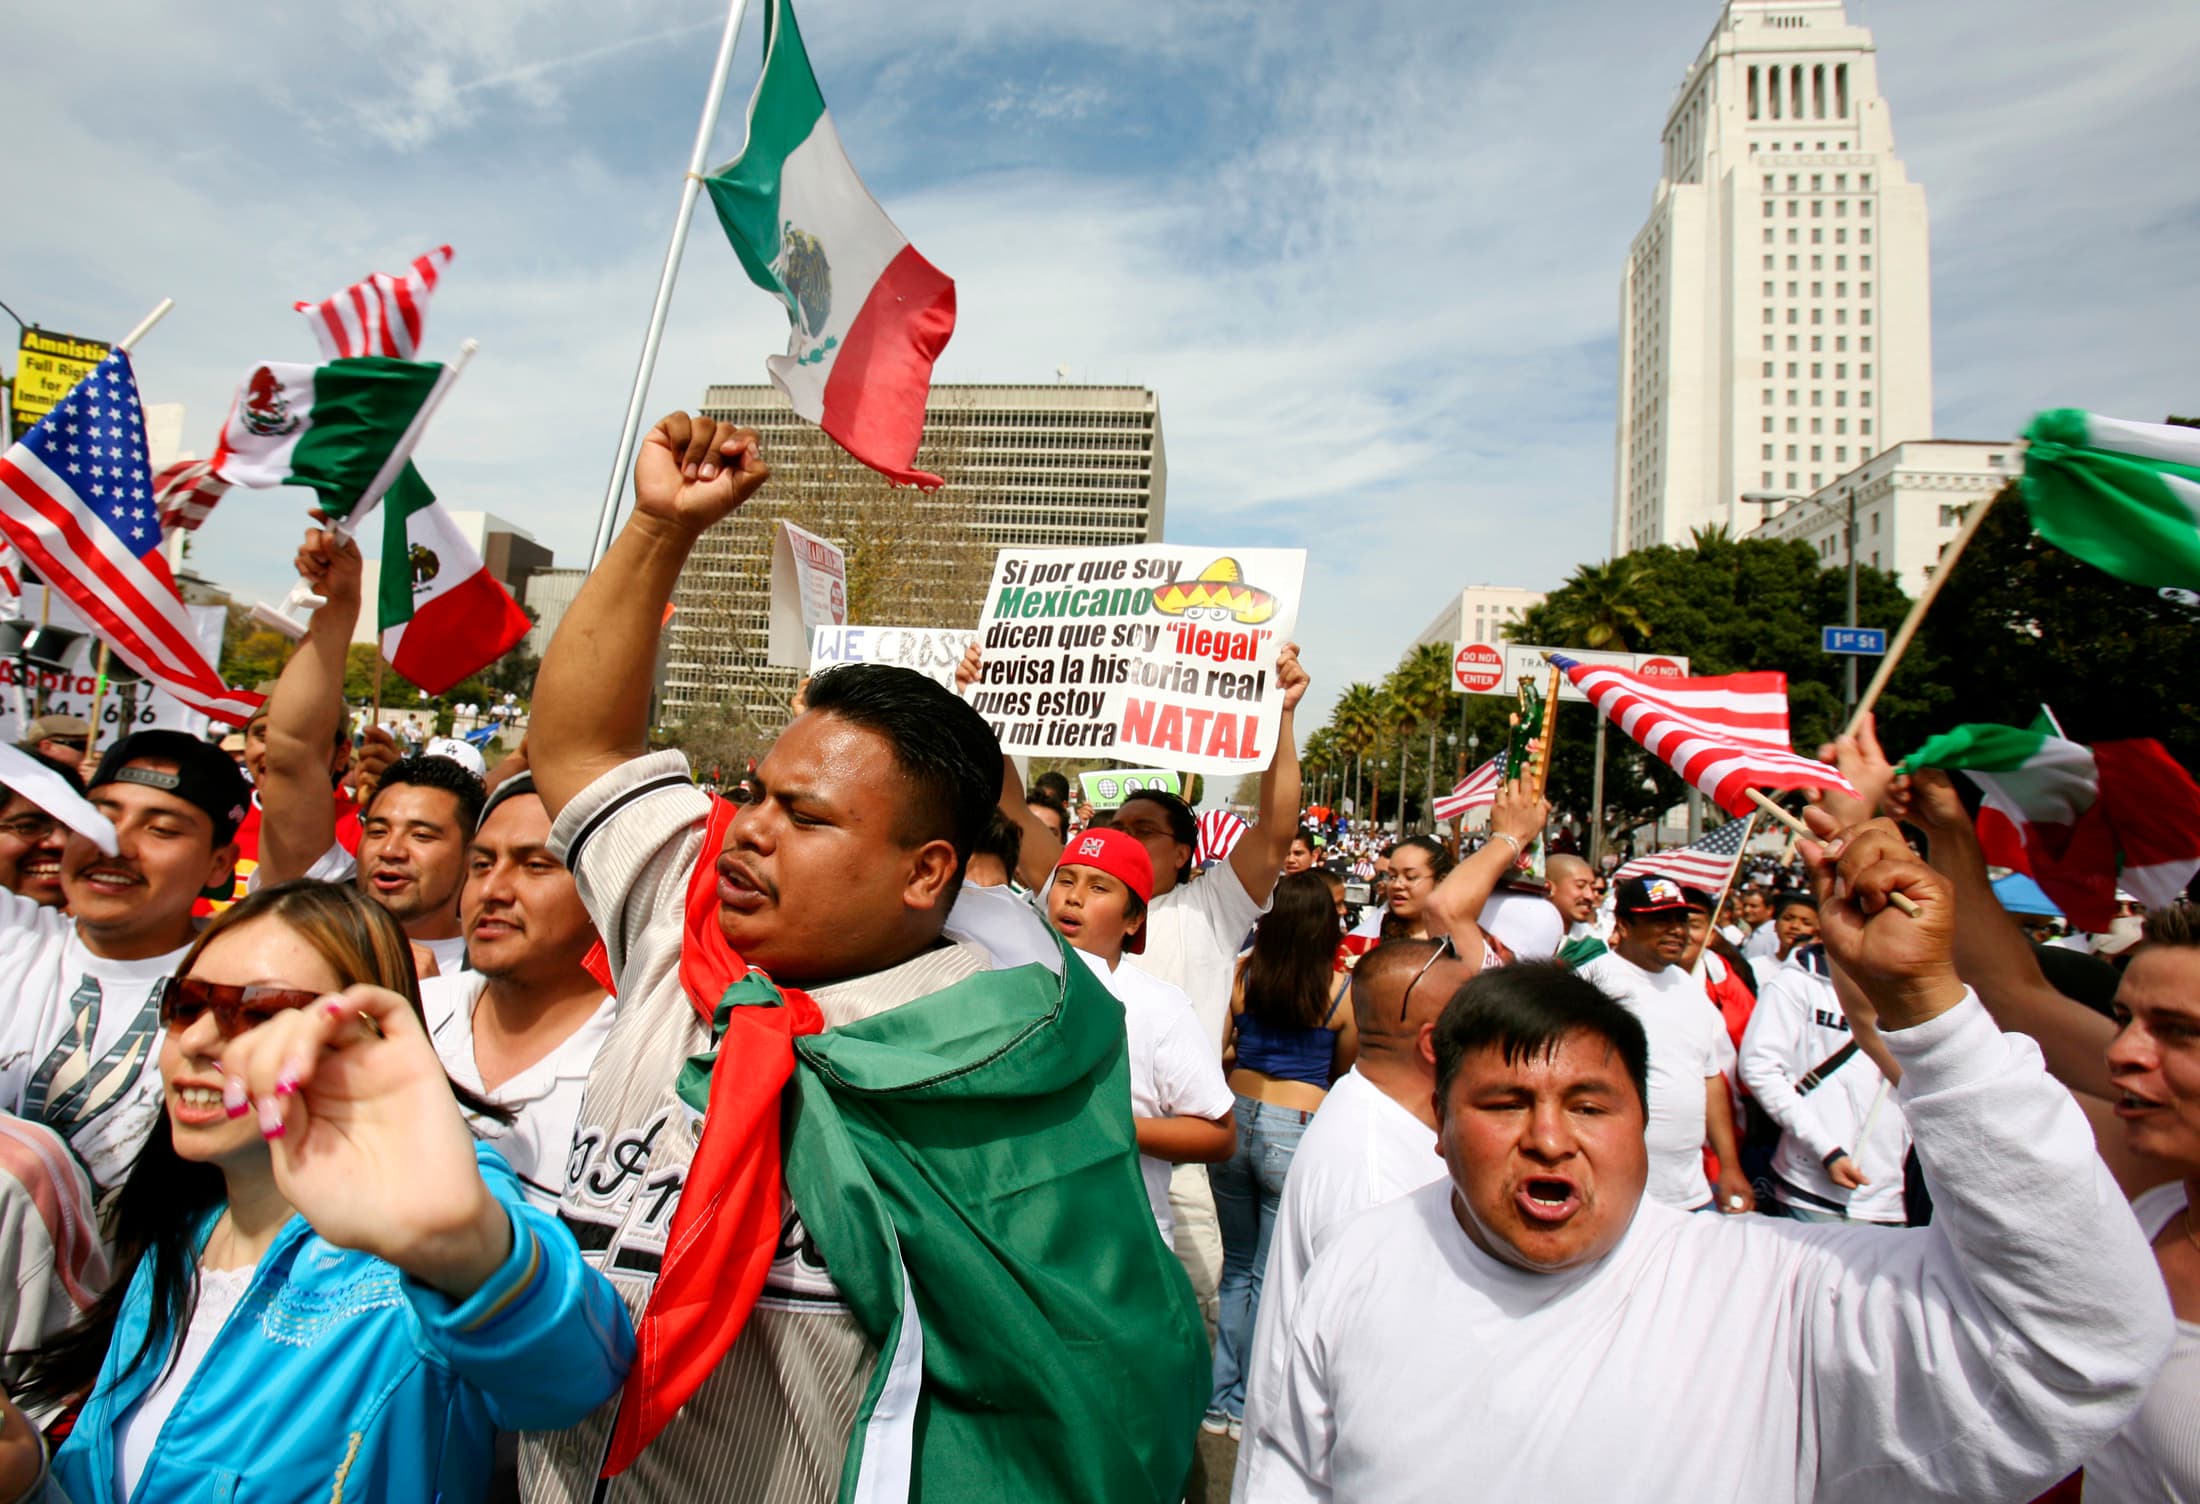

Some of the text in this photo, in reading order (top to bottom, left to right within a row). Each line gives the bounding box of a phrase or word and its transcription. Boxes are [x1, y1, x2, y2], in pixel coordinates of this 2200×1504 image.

[25, 357, 53, 373] Full
[40, 378, 61, 392] for
[1002, 558, 1183, 586] Si por que soy
[993, 585, 1153, 619] Mexicano
[817, 630, 865, 661] WE
[985, 621, 1053, 649] dicen
[1057, 624, 1106, 650] que
[1111, 623, 1160, 652] soy
[1834, 632, 1876, 648] 1st St
[1462, 652, 1497, 663] DO NOT
[1644, 664, 1678, 676] DO NOT
[980, 655, 1055, 685] revisa
[1059, 654, 1085, 684] la
[1089, 653, 1199, 695] historia
[1205, 669, 1266, 702] real
[1464, 674, 1494, 686] ENTER
[1036, 688, 1106, 719] estoy
[1008, 719, 1044, 746] mi
[1047, 718, 1117, 747] tierra
[1120, 697, 1261, 760] NATAL
